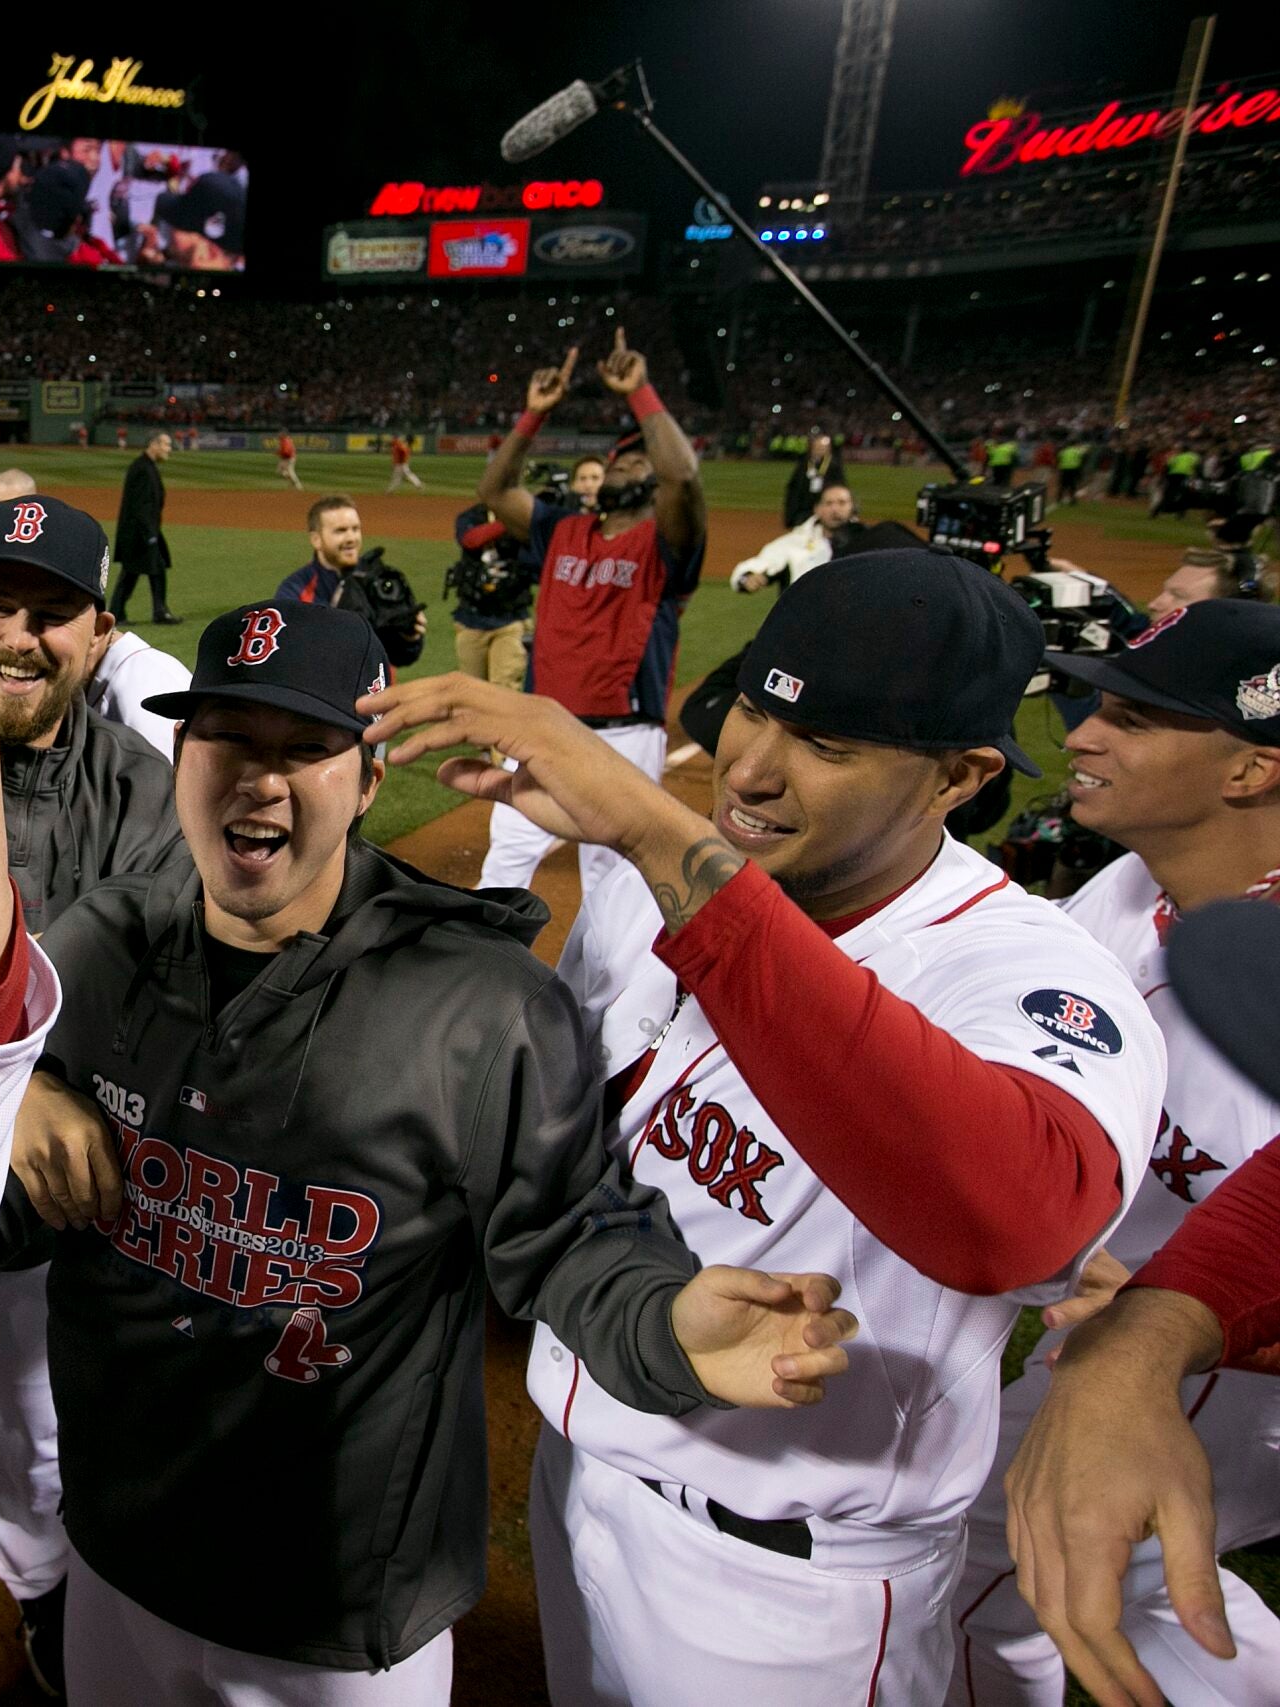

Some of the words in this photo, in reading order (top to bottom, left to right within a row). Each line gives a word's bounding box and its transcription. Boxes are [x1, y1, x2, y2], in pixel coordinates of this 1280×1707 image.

[19, 52, 99, 131] John
[96, 56, 186, 108] Hancoc
[423, 187, 481, 212] new
[5, 502, 48, 544] B
[227, 608, 287, 666] B
[1031, 1012, 1111, 1054] STRONG
[92, 1073, 147, 1127] 2013
[645, 1084, 785, 1227] SOX
